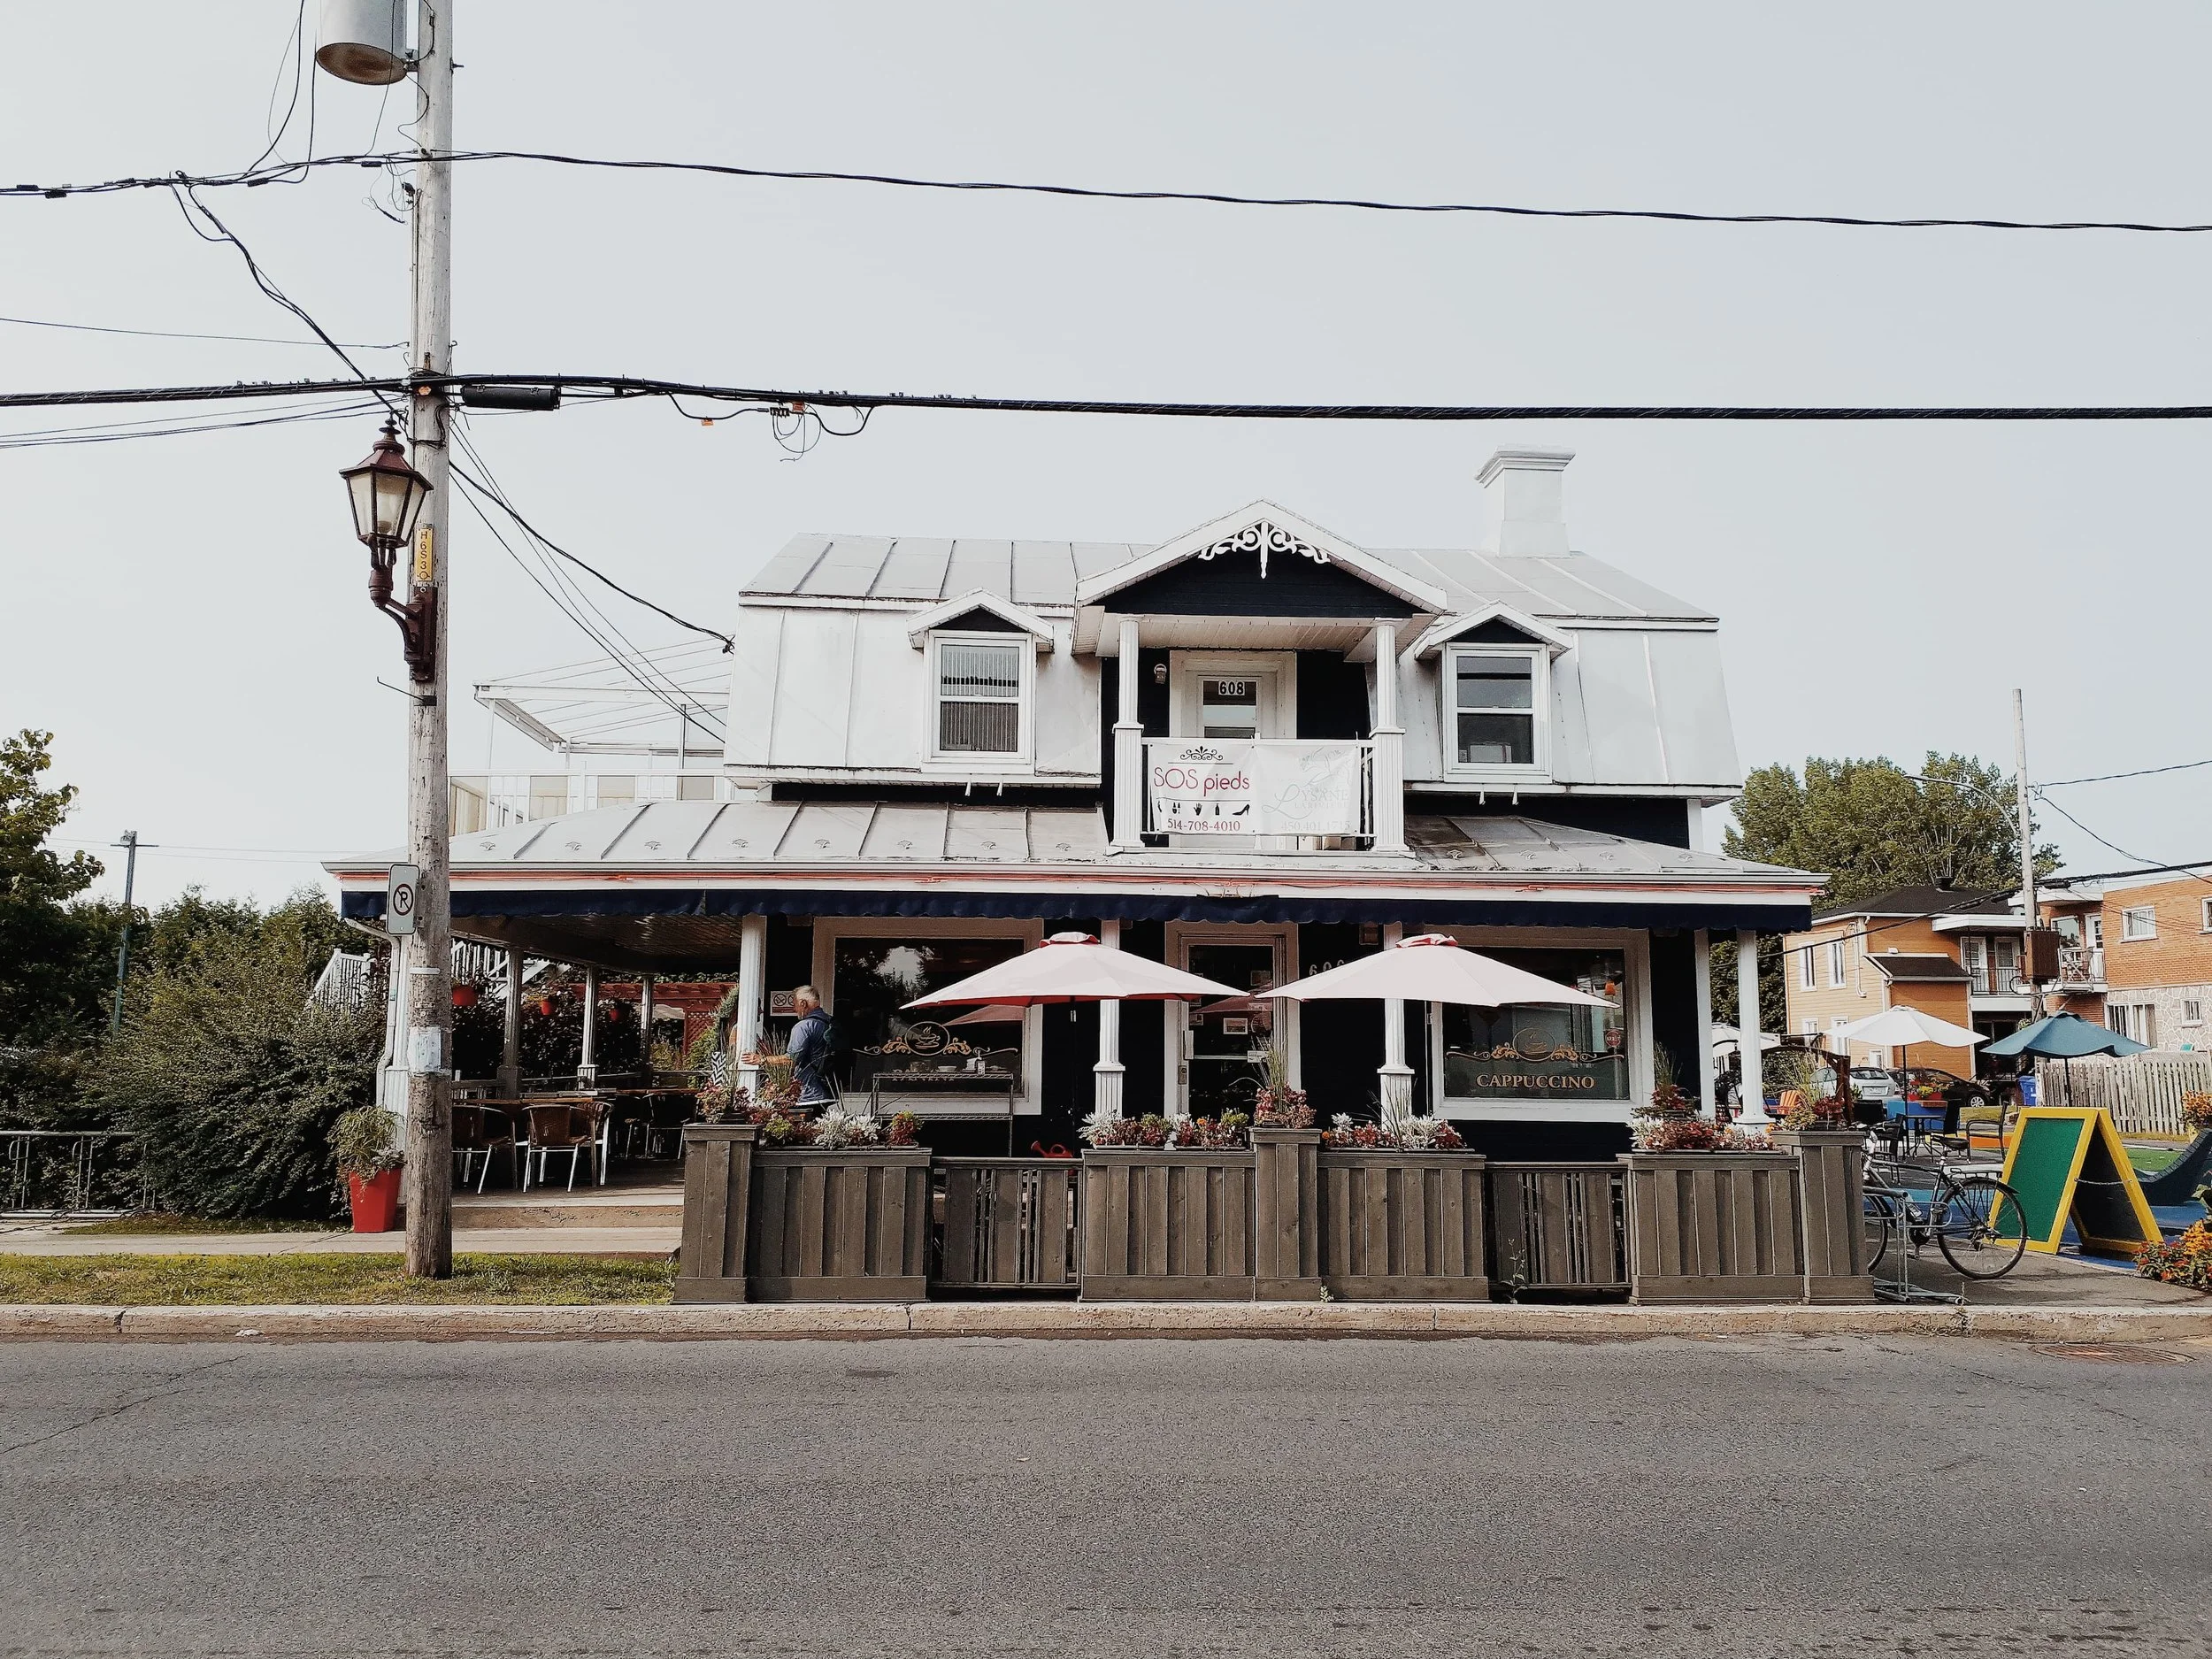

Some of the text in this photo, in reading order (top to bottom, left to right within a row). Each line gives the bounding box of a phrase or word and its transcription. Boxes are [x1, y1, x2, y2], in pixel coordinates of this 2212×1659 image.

[1219, 681, 1244, 695] 608
[1153, 767, 1250, 796] SOS pieds
[1167, 818, 1240, 832] 514-708-4010
[1476, 1074, 1595, 1089] CAPPUCCINO
